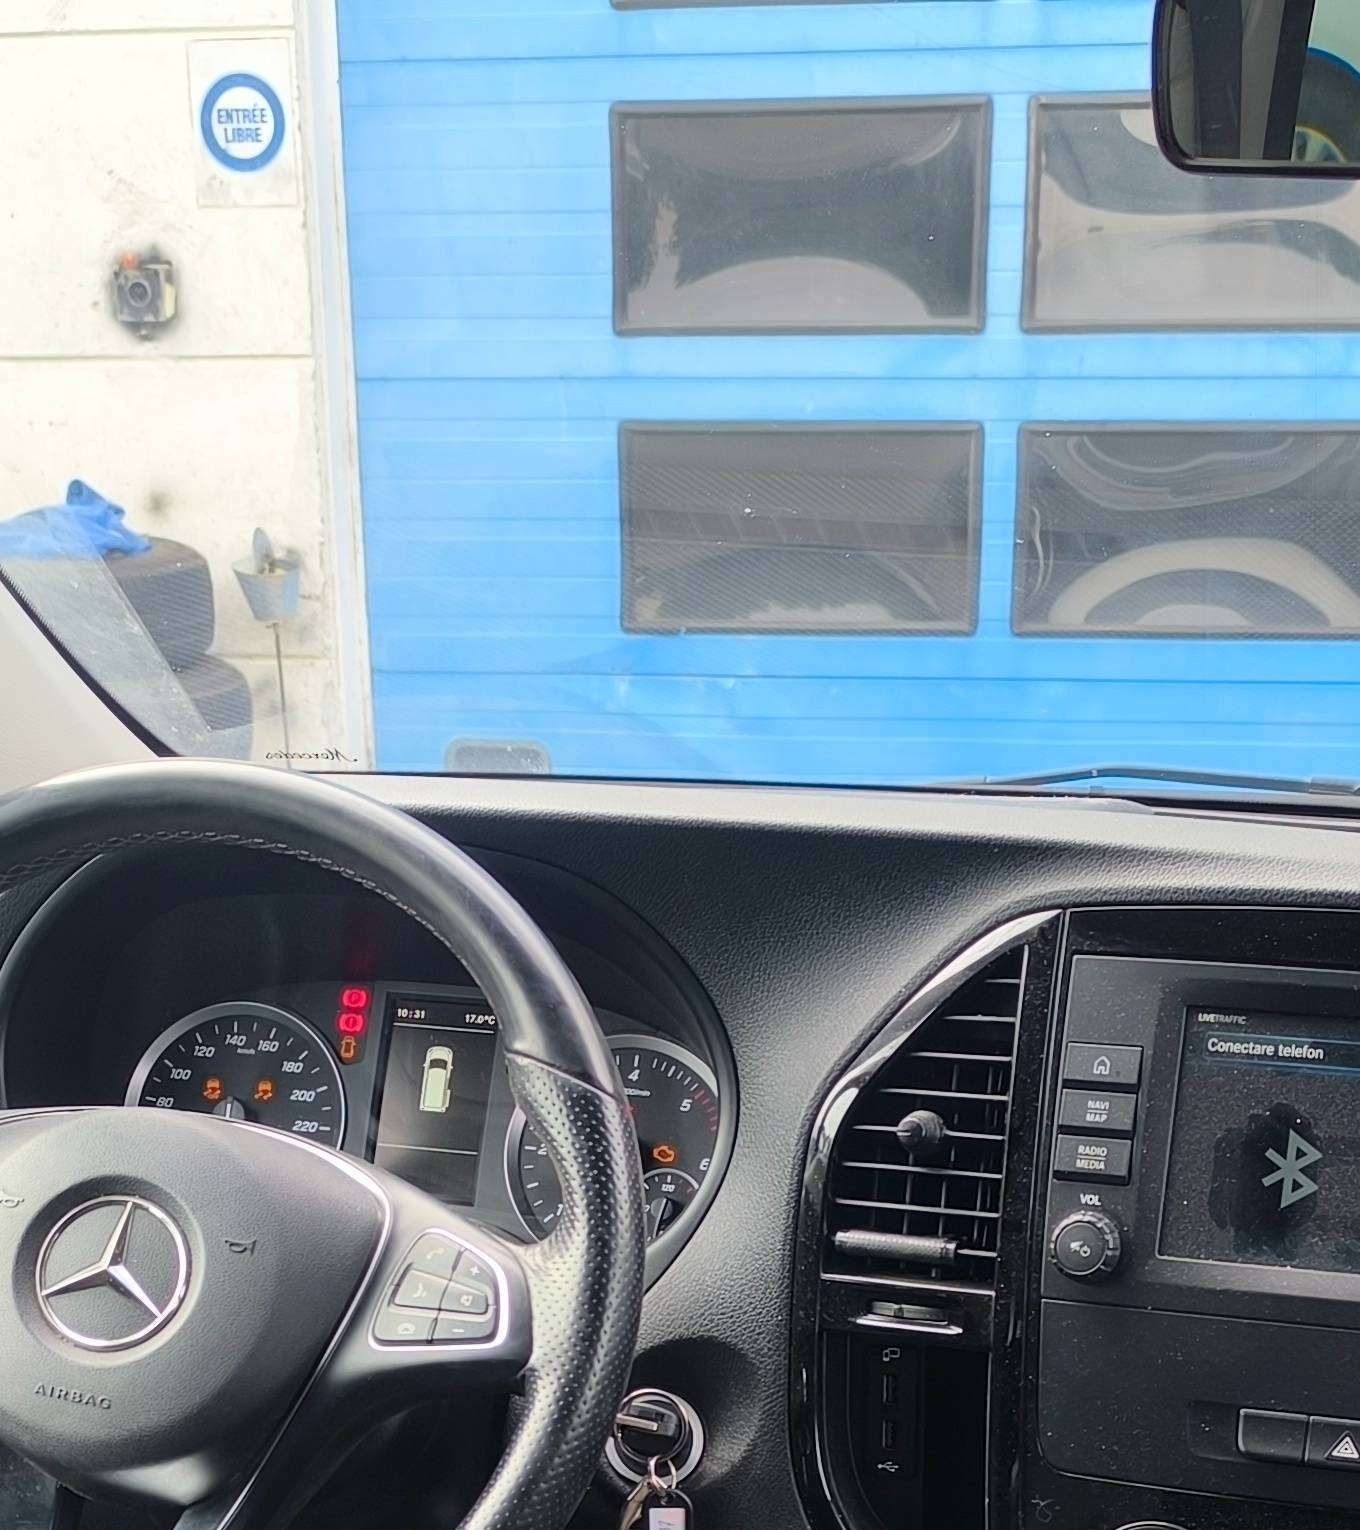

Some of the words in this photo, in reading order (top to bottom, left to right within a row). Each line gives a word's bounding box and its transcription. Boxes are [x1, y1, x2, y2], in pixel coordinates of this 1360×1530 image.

[217, 104, 268, 124] ENTRÉE
[224, 128, 263, 143] LIBRE
[398, 1008, 426, 1019] 10:31
[225, 1034, 247, 1046] 140
[258, 1040, 280, 1052] 160
[194, 1045, 215, 1057] 120
[1207, 1037, 1275, 1056] Conectare
[1278, 1044, 1324, 1060] telefon
[282, 1061, 304, 1073] 180
[170, 1068, 191, 1080] 100
[627, 1069, 640, 1081] 4
[290, 1090, 315, 1101] 200
[156, 1097, 174, 1108] 80
[679, 1099, 693, 1112] 5
[1087, 1101, 1110, 1110] NAVI
[1085, 1113, 1107, 1123] MAP
[292, 1121, 318, 1132] 220
[1077, 1145, 1107, 1157] RADIO
[700, 1158, 710, 1171] 6
[1075, 1159, 1105, 1170] MEDIA
[1080, 1193, 1101, 1206] VOL
[34, 1382, 112, 1409] AIRBAG
